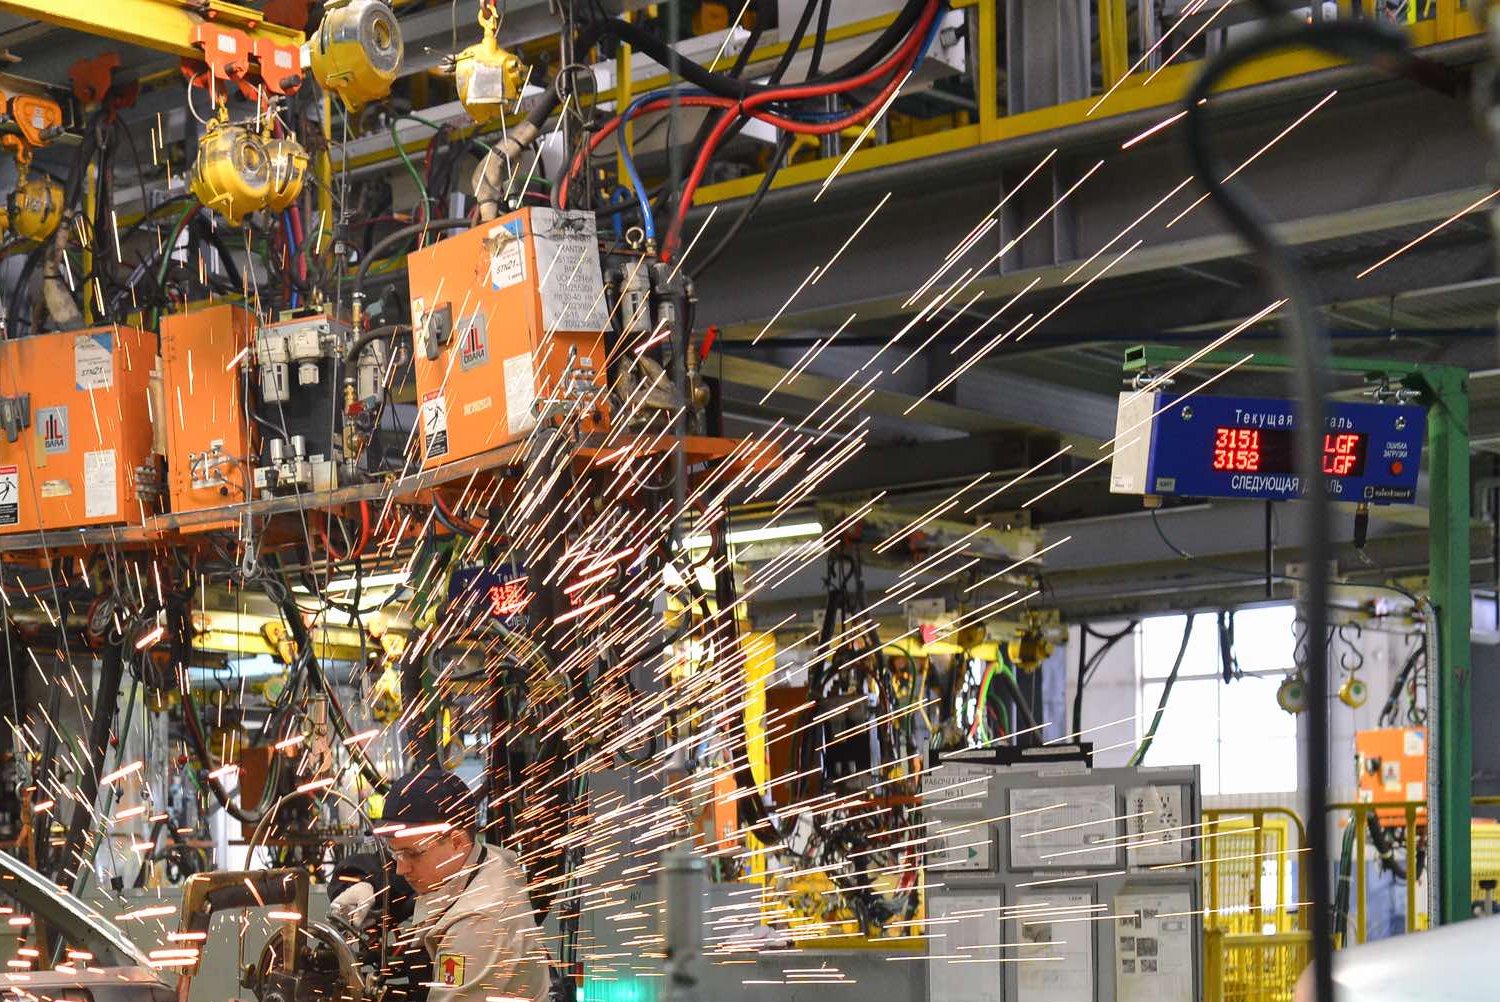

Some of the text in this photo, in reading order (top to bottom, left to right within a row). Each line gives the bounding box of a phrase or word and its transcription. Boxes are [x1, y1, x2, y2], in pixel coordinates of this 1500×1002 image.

[1235, 409, 1293, 427] Текущая
[1216, 428, 1359, 454] 3151 LGF
[1213, 449, 1356, 474] 3152 LGF
[1231, 475, 1299, 493] СЛЕДУЮЩАЯ
